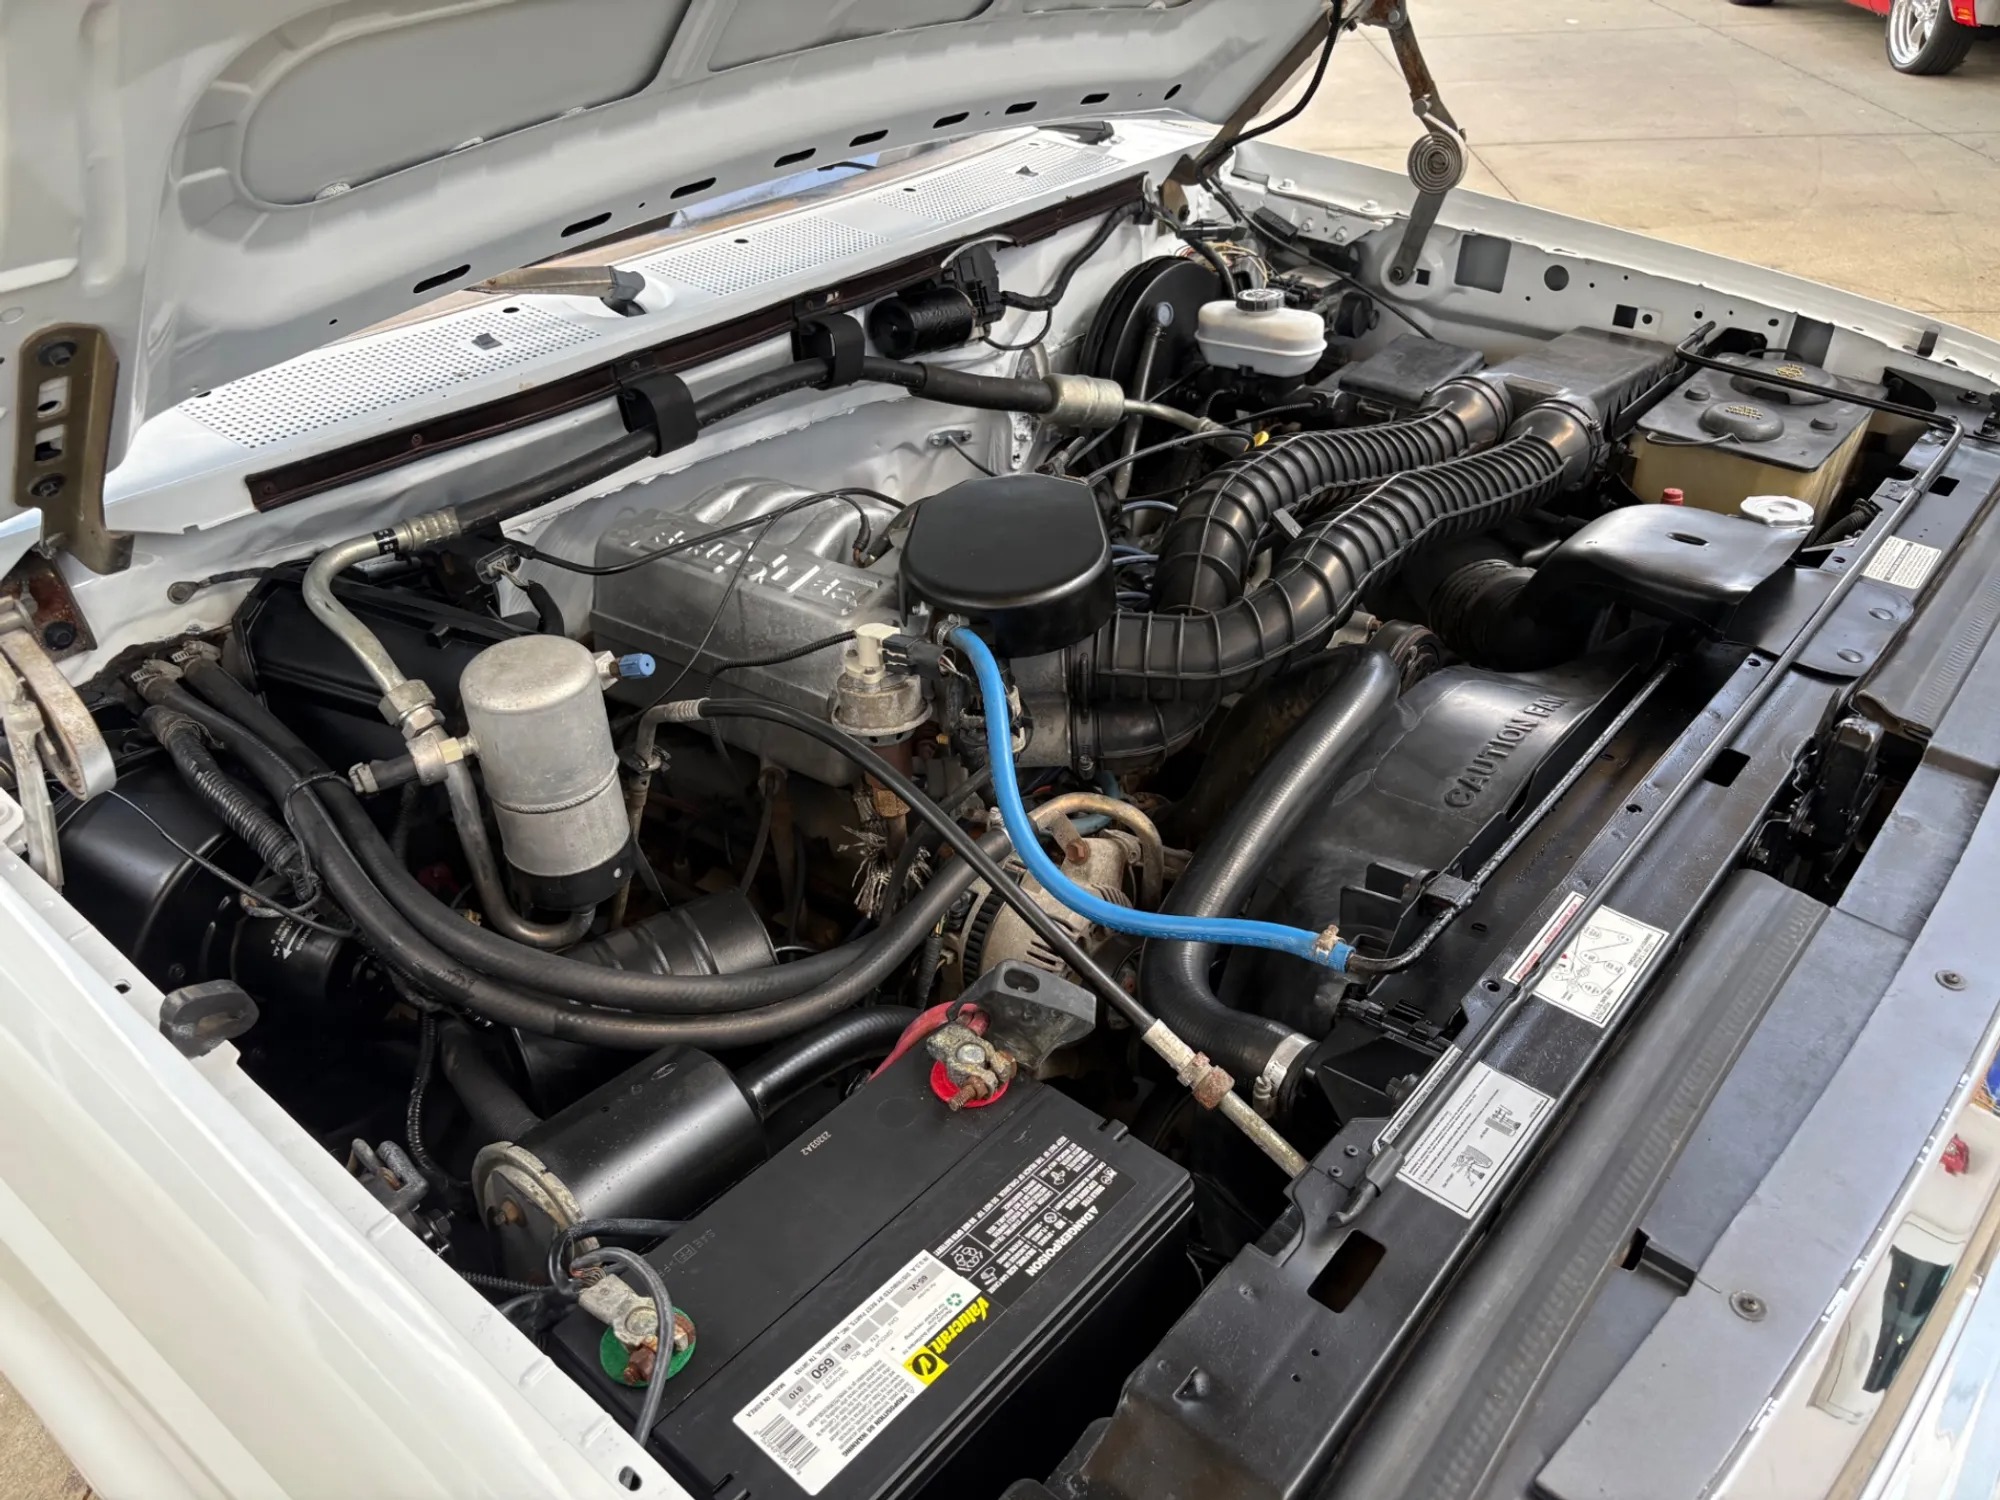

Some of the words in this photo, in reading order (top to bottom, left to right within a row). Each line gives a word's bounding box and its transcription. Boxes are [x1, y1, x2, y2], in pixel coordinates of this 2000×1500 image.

[1444, 720, 1538, 807] CAUTION
[1024, 1211, 1094, 1276] DANGER/POISON
[907, 1274, 928, 1292] 65-VL
[927, 1296, 996, 1358] Valucraft
[809, 1357, 835, 1379] 650
[788, 1385, 803, 1399] 810
[841, 1431, 868, 1456] WARNING
